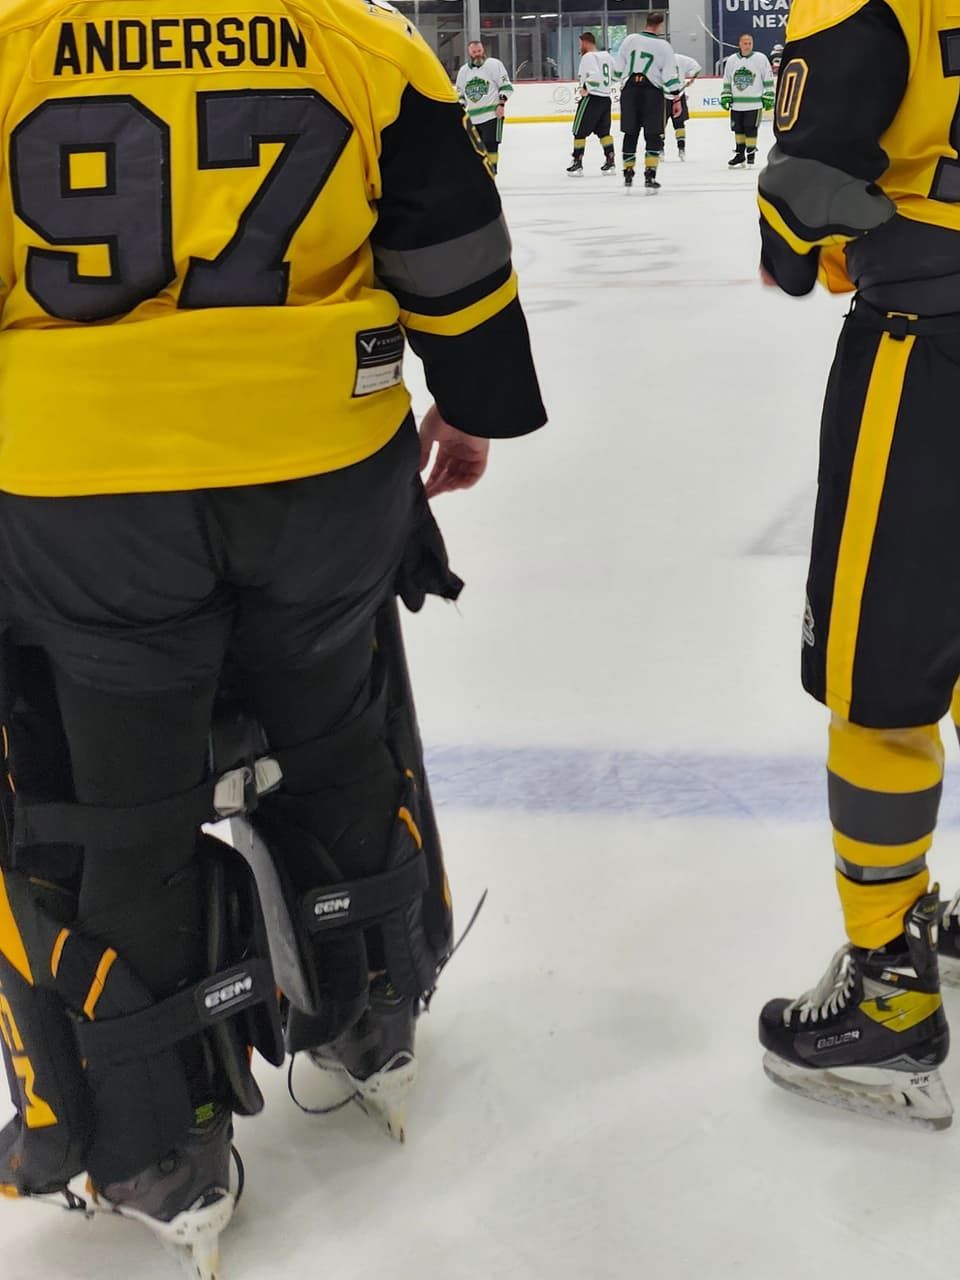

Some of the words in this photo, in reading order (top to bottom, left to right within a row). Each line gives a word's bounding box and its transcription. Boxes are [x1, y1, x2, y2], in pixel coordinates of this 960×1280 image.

[53, 16, 307, 76] ANDERSON
[629, 49, 654, 76] 17
[602, 63, 610, 86] 9
[9, 88, 354, 322] 97
